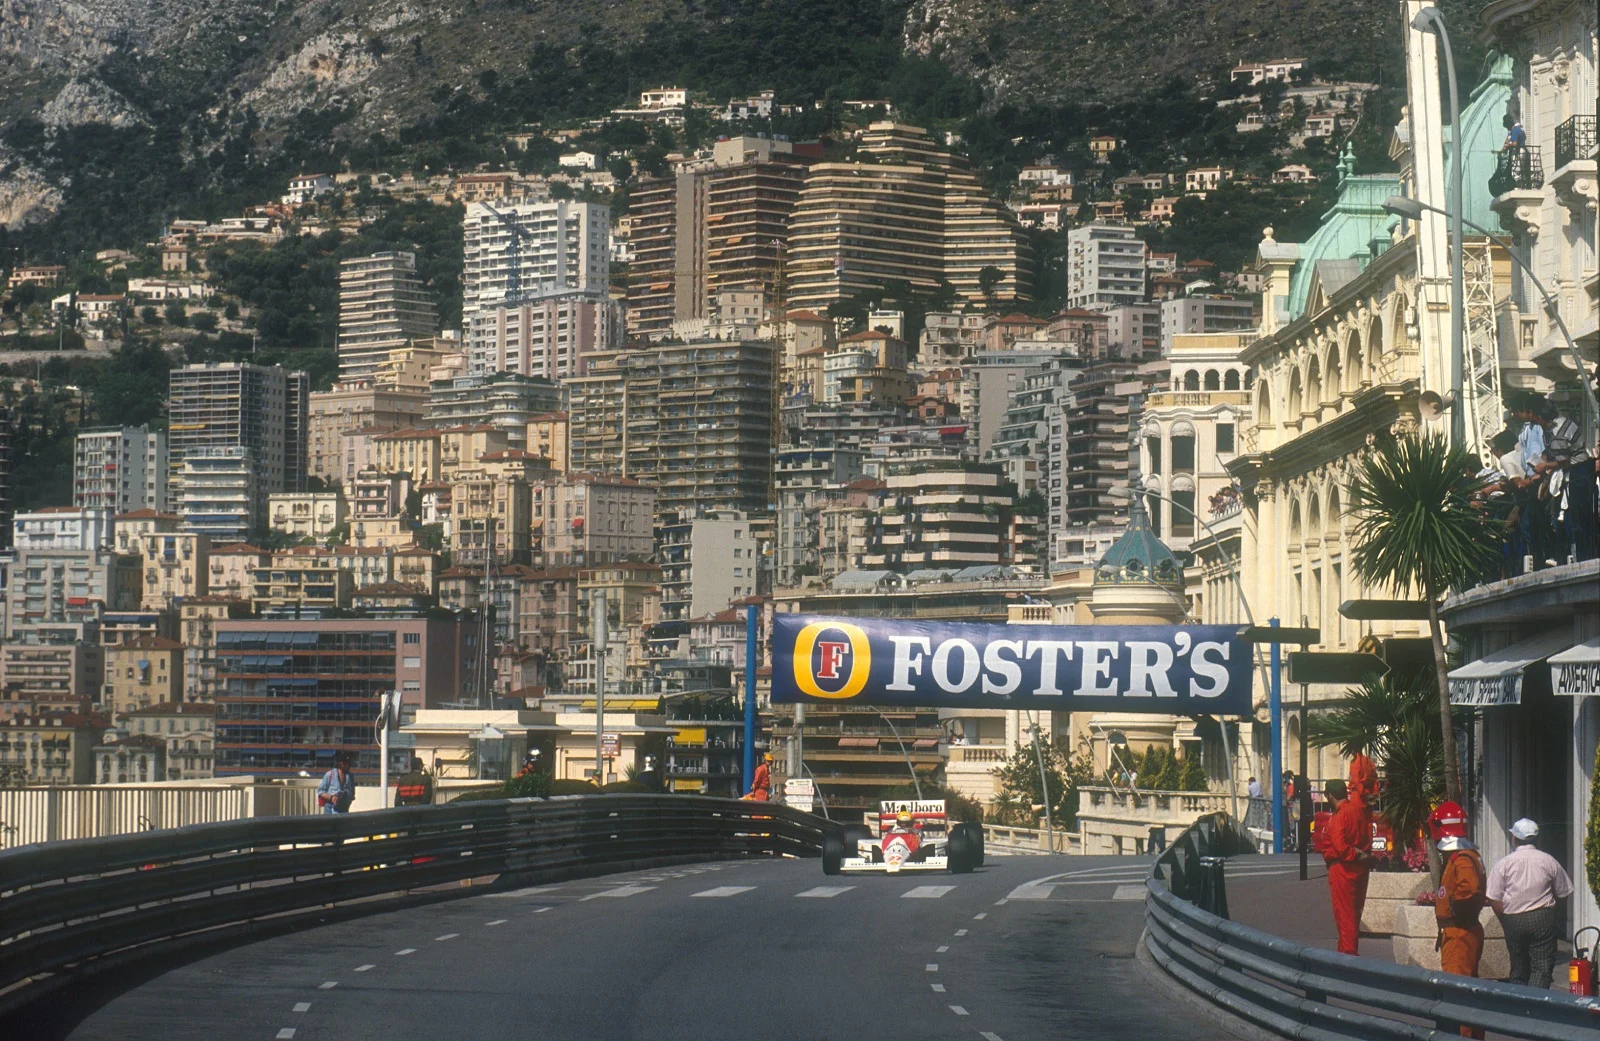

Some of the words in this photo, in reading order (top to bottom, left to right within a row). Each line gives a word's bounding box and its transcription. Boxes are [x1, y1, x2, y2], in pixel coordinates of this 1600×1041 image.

[885, 631, 1230, 698] FOSTER'S
[1477, 677, 1500, 703] EPRESS
[885, 802, 942, 813] Malboro
